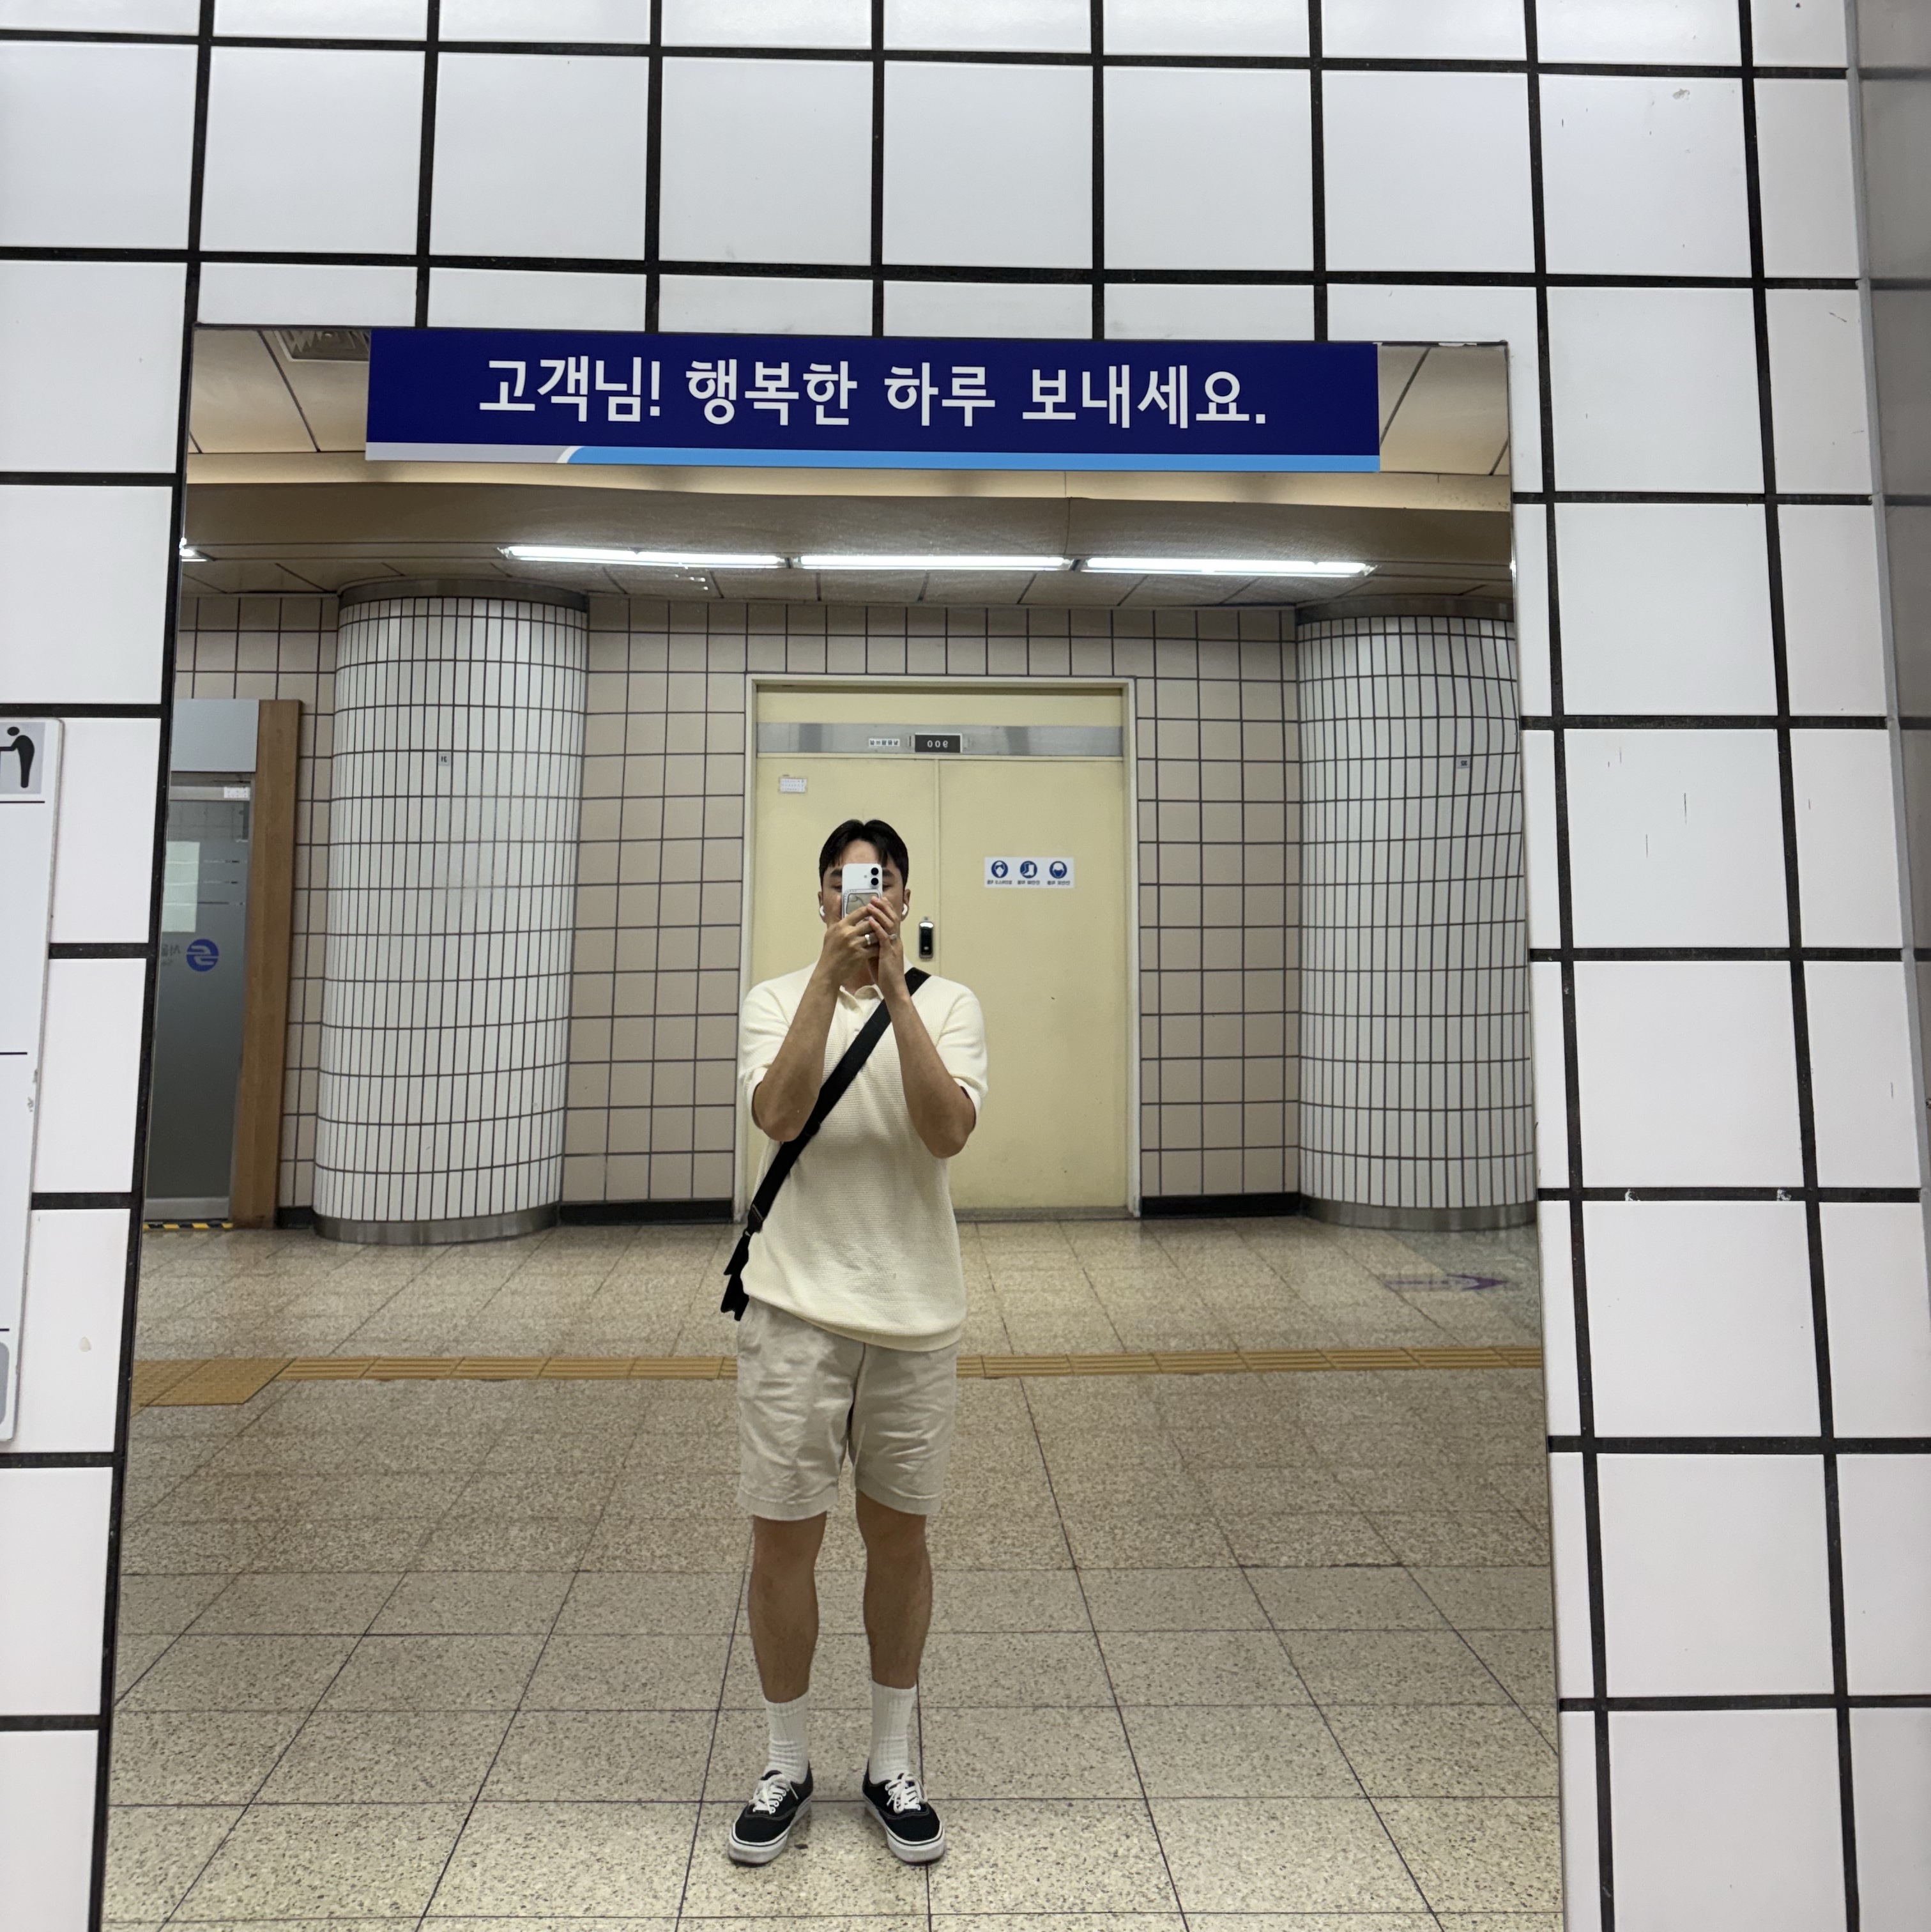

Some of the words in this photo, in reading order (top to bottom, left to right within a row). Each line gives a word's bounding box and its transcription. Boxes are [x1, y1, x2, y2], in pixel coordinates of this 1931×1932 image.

[480, 356, 661, 423] 고객님!
[686, 359, 858, 426] 행복한
[885, 362, 996, 427] 하루
[1023, 365, 1267, 429] 보내세요.
